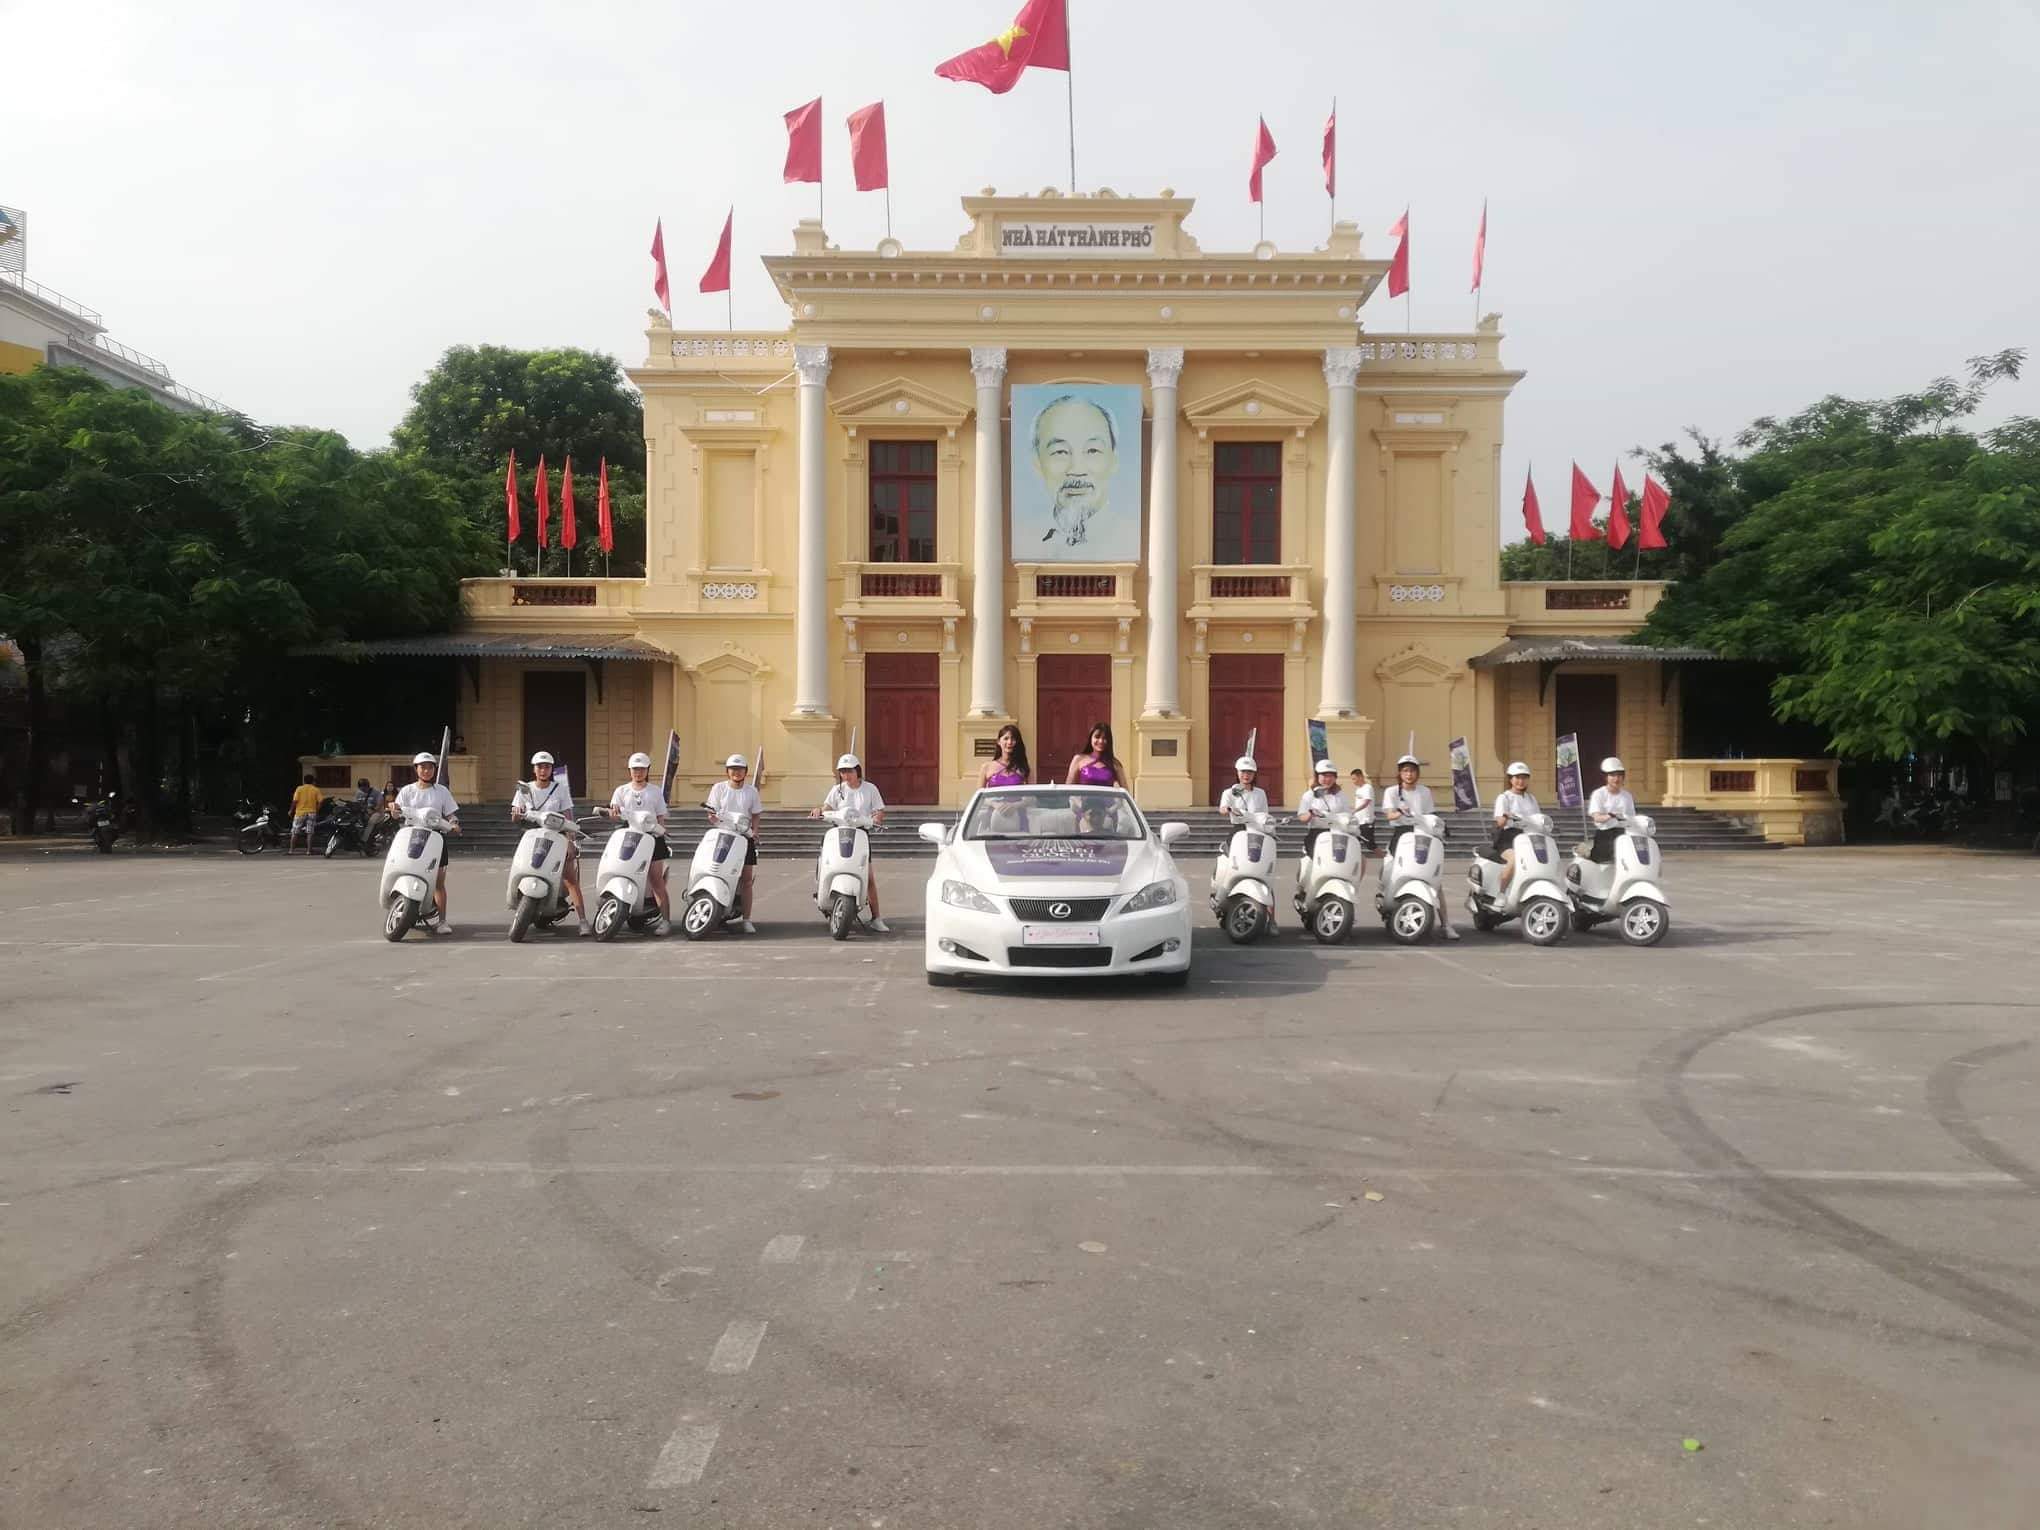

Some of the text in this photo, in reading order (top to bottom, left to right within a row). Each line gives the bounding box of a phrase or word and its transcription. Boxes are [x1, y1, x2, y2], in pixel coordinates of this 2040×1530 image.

[1002, 224, 1154, 247] NHÀ HÁT THÀNH PHỐ
